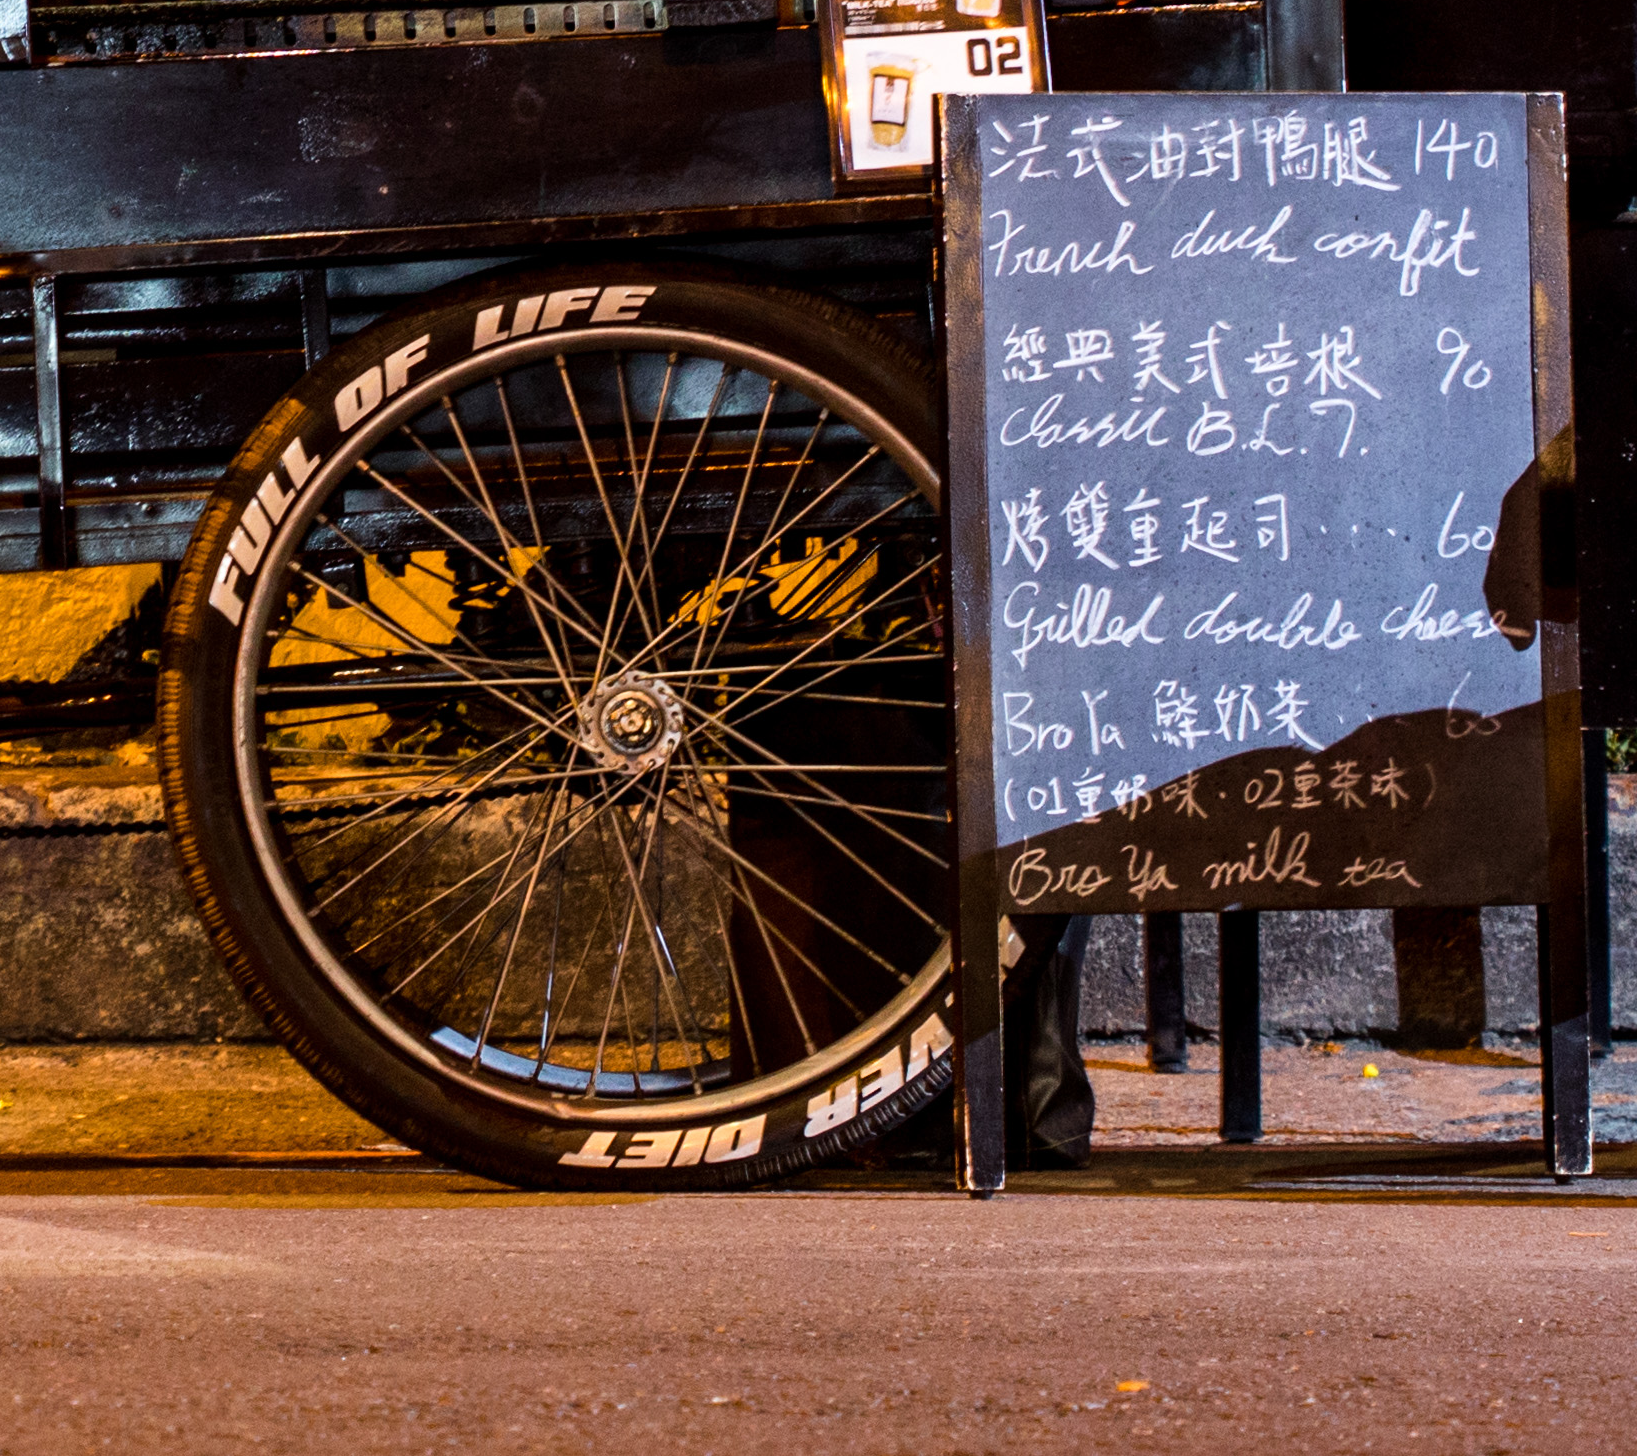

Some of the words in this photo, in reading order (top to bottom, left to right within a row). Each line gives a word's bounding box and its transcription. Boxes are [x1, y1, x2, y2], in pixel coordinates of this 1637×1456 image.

[966, 35, 1024, 76] 02
[1415, 119, 1498, 180] 140
[989, 209, 1155, 277] French
[1171, 205, 1297, 263] duck
[1314, 207, 1479, 296] confit
[1002, 321, 1382, 400] 經典美式培根
[1437, 327, 1492, 394] 90
[209, 436, 323, 627] FULL
[333, 333, 431, 433] OF
[471, 284, 659, 353] LIFE
[1438, 491, 1495, 559] 60
[1004, 581, 1165, 671] Grilled
[1184, 591, 1362, 649] double
[1381, 583, 1531, 640] cheese
[1445, 671, 1502, 739] 60
[1008, 835, 1112, 905] Bro
[1121, 844, 1179, 901] Ya
[1202, 826, 1322, 890] milk
[1337, 857, 1423, 889] tea
[558, 1112, 767, 1169] DIET
